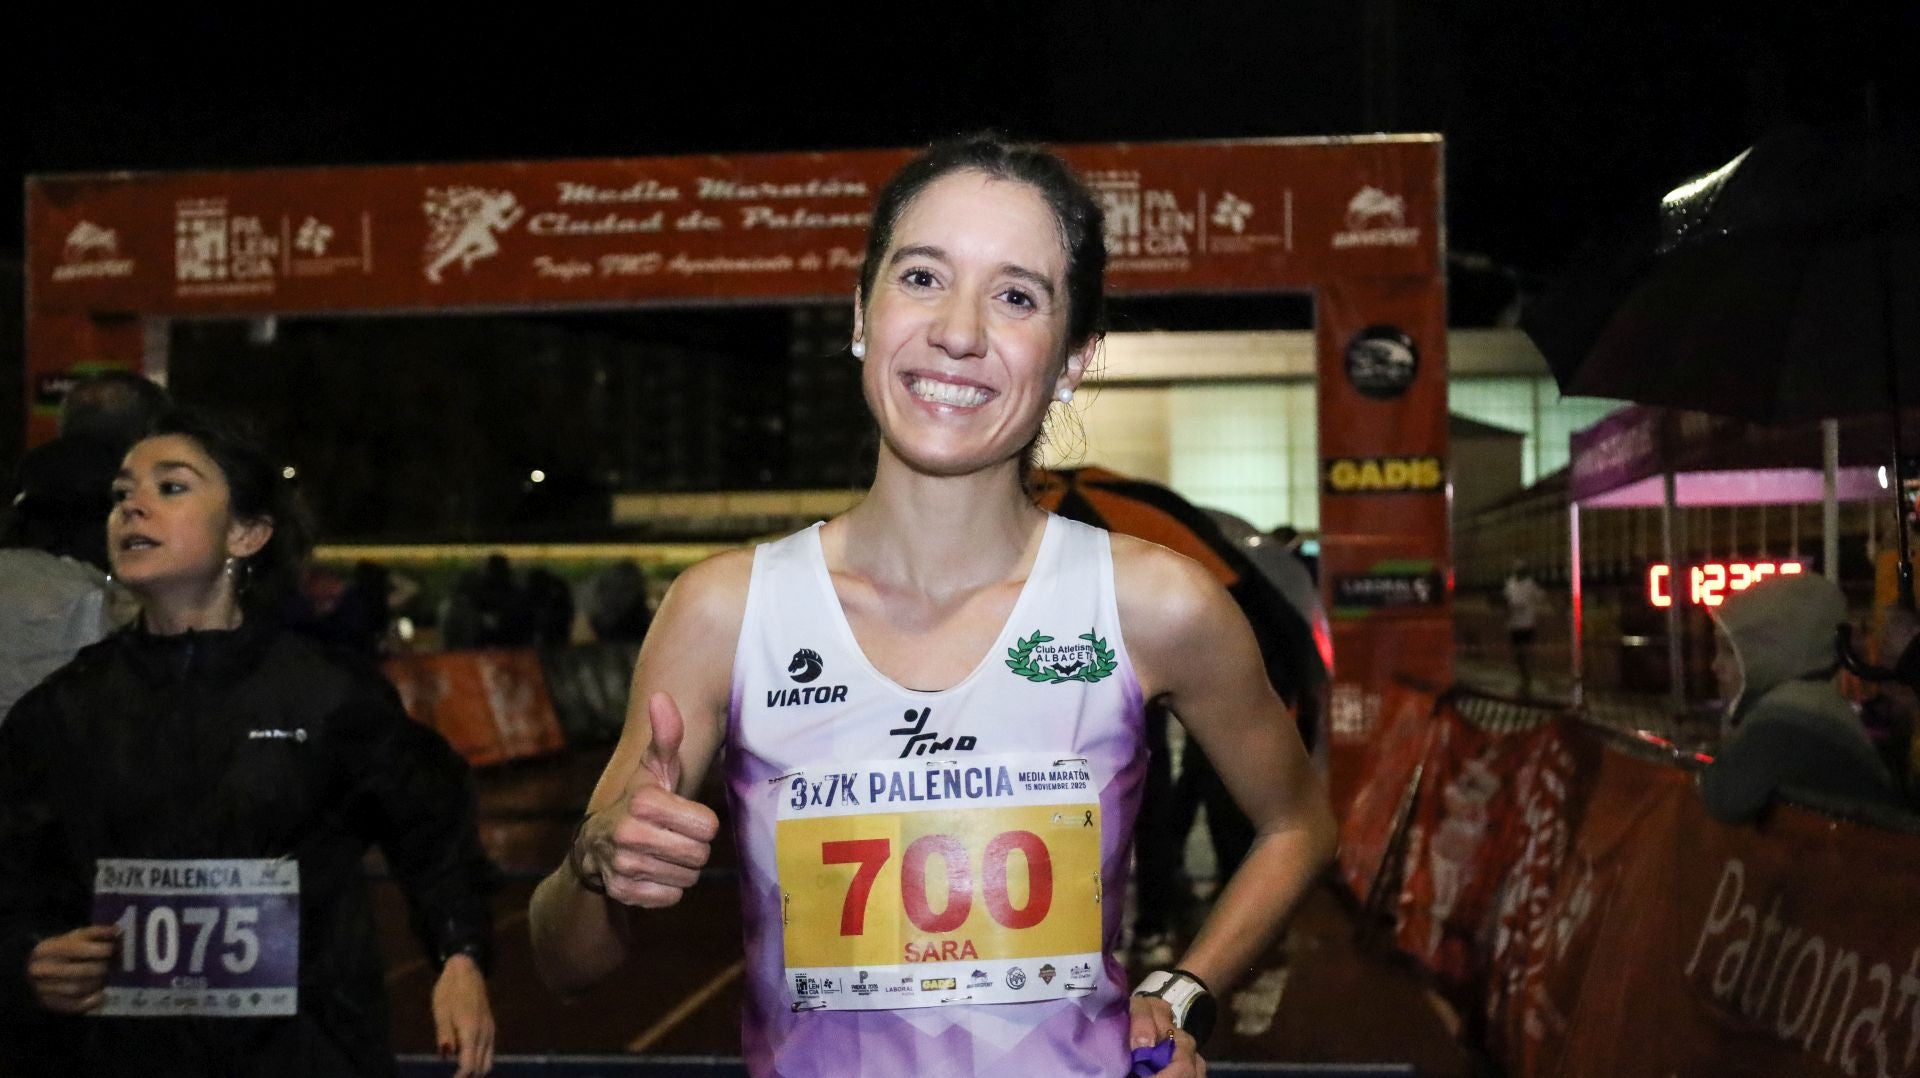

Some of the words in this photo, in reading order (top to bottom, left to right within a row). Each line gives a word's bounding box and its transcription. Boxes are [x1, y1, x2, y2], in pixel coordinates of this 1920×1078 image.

[527, 210, 664, 236] Ciudad
[676, 210, 723, 231] de
[1330, 458, 1441, 490] GADIS
[1035, 645, 1056, 654] Club
[766, 684, 848, 708] VIATOR
[1018, 771, 1046, 781] MEDIA
[1049, 768, 1090, 781] MARATÓN
[1033, 782, 1069, 791] NOVIEMBRE
[1071, 781, 1087, 790] 2025
[791, 772, 860, 810] 3x7K
[869, 766, 1014, 803] PALENCIA
[151, 867, 243, 888] PALENCIA
[821, 830, 1053, 937] 700
[115, 904, 260, 974] 1075
[904, 939, 979, 964] SARA
[1684, 857, 1920, 1078] Patronat
